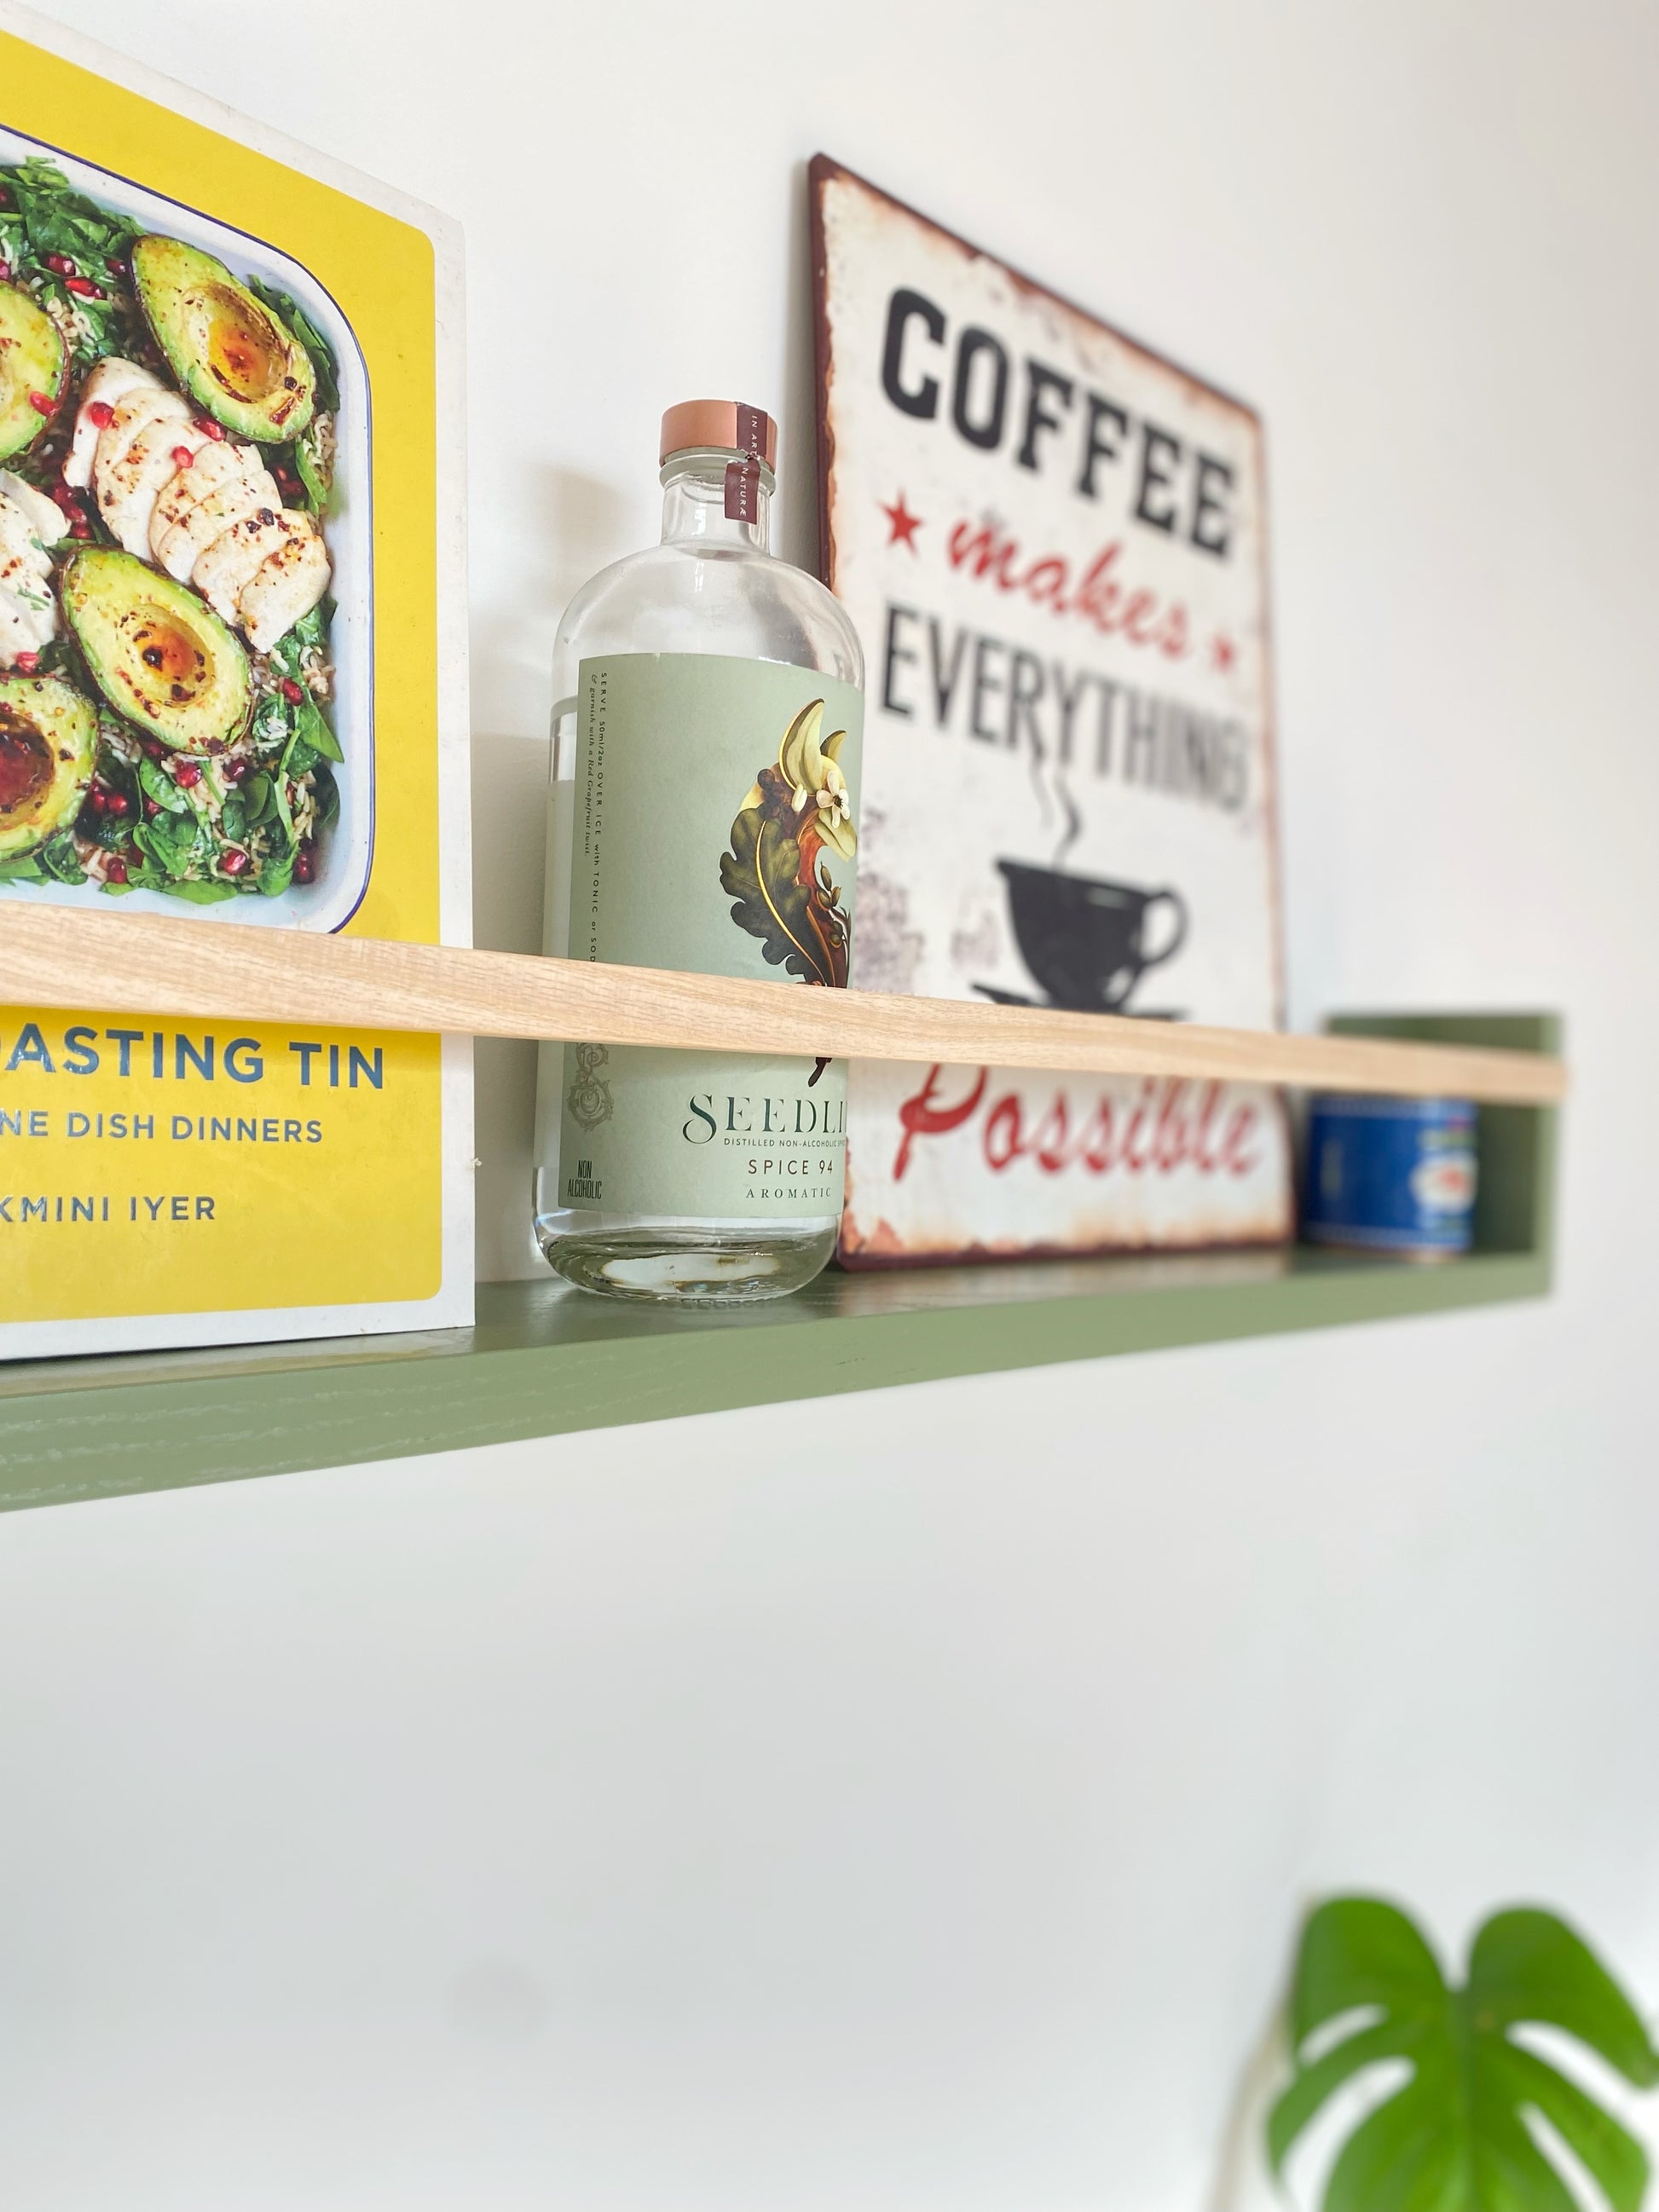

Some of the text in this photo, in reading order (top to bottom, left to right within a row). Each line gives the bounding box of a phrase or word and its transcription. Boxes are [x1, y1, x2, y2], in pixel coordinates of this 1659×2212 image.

[751, 415, 758, 427] IN
[879, 286, 1235, 560] COFFEE
[946, 519, 1189, 661] makes
[880, 598, 1250, 812] EVERYTHING
[585, 780, 594, 828] Grapefruit
[592, 871, 600, 913] TONIC
[591, 921, 596, 931] or
[0, 1022, 384, 1089] ASTING TIN
[67, 1112, 153, 1139] DISH
[171, 1116, 322, 1142] DINNERS
[682, 1094, 847, 1144] SEEDLI
[893, 1063, 1259, 1181] Possible
[724, 1138, 775, 1147] DISTILLED
[578, 1160, 592, 1179] NON
[748, 1159, 834, 1175] SPICE 94
[568, 1179, 603, 1199] ALCOHOLIC
[746, 1187, 832, 1199] AROMATIC
[130, 1196, 216, 1221] IYER
